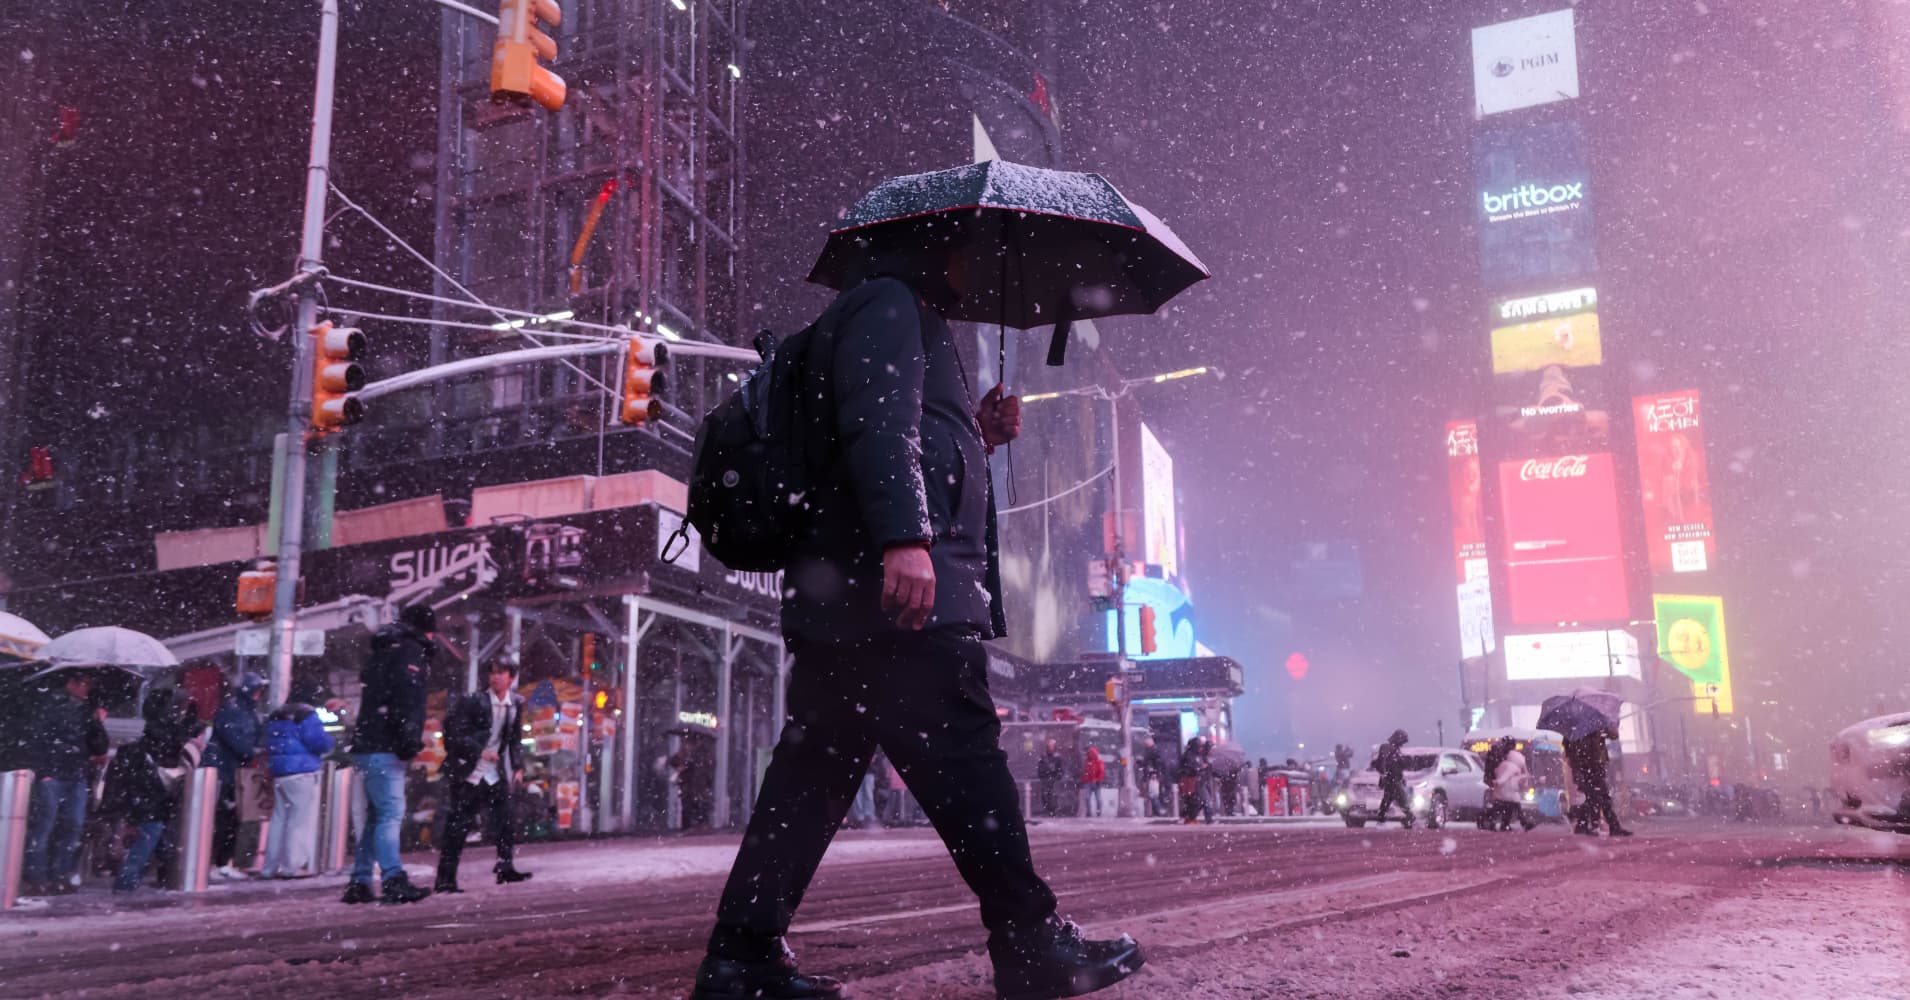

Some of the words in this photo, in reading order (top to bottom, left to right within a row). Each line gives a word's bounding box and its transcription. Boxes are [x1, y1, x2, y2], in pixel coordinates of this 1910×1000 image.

[1520, 52, 1560, 71] PGIM
[1483, 182, 1583, 213] britbox
[1521, 407, 1537, 417] No
[1538, 402, 1579, 416] worries
